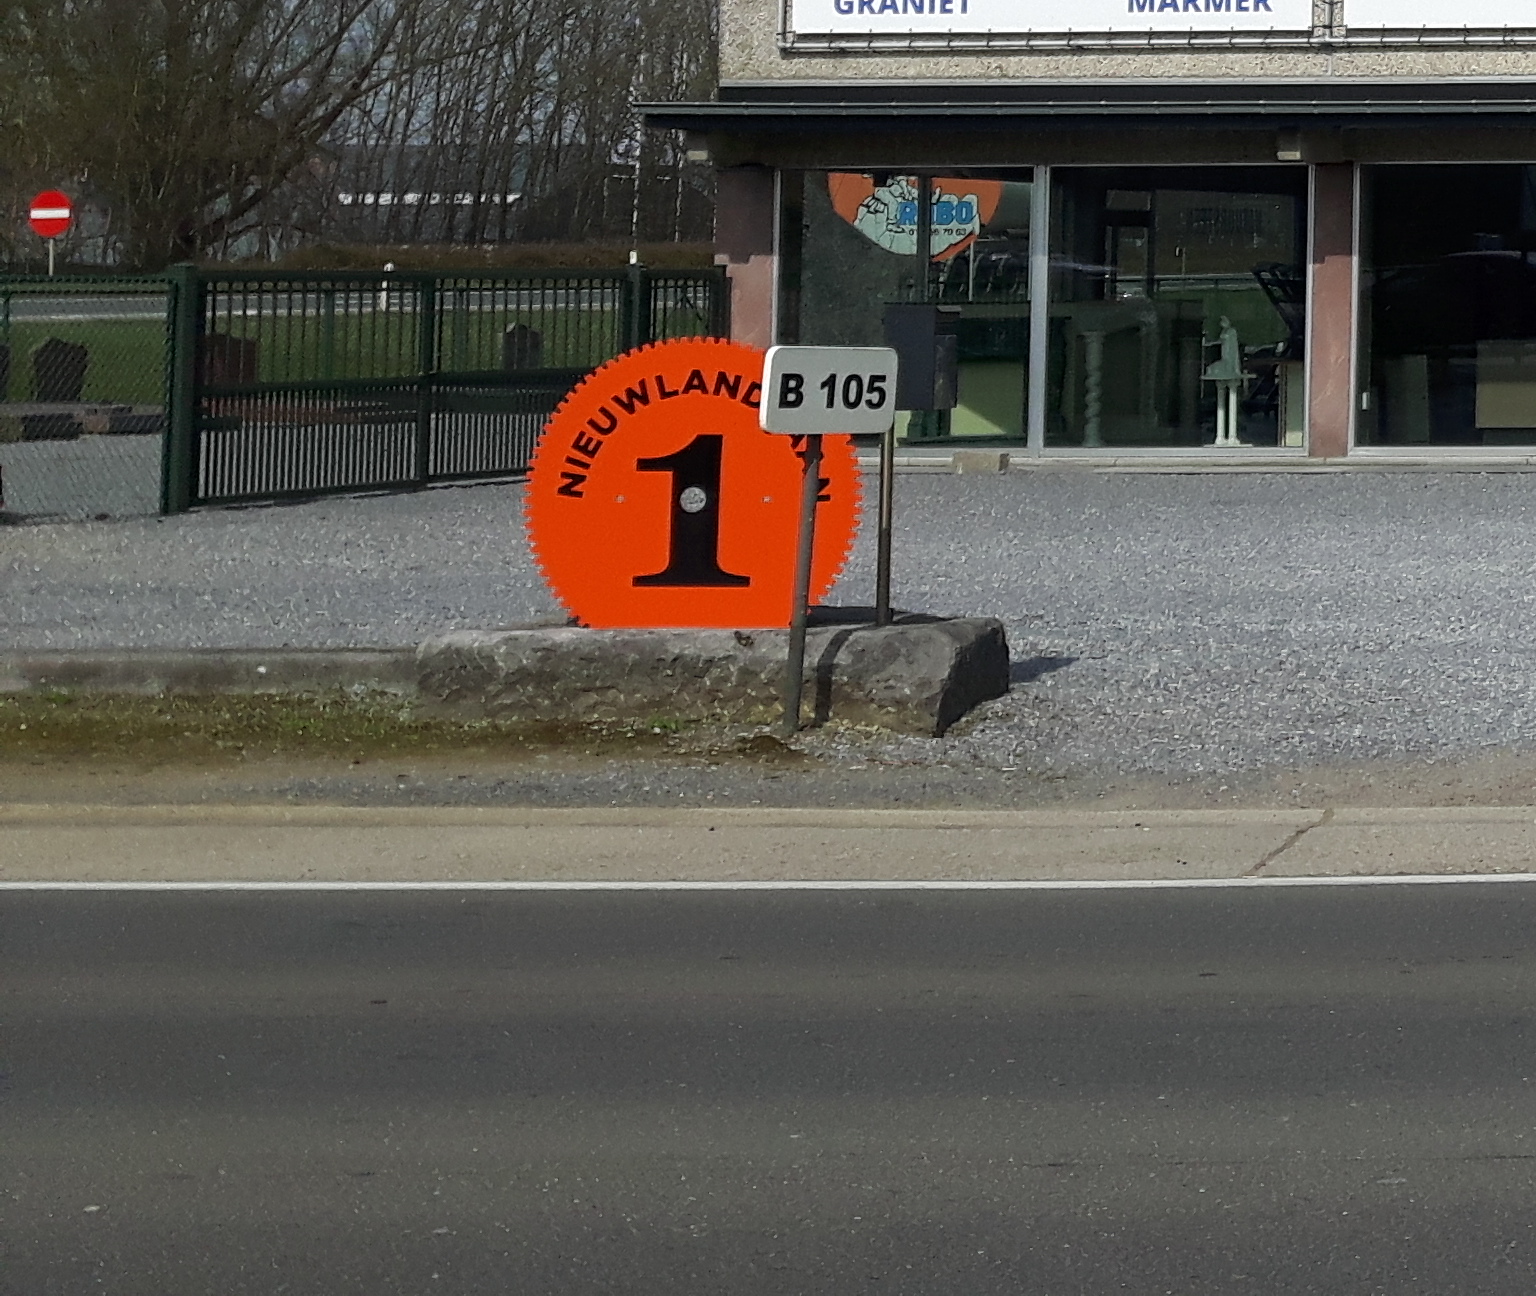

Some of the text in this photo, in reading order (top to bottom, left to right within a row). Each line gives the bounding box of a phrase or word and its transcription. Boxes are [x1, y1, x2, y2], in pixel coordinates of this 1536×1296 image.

[898, 201, 974, 226] RBO
[779, 374, 886, 409] B 105
[556, 368, 831, 502] NIEUWLAND
[632, 434, 750, 587] 1
